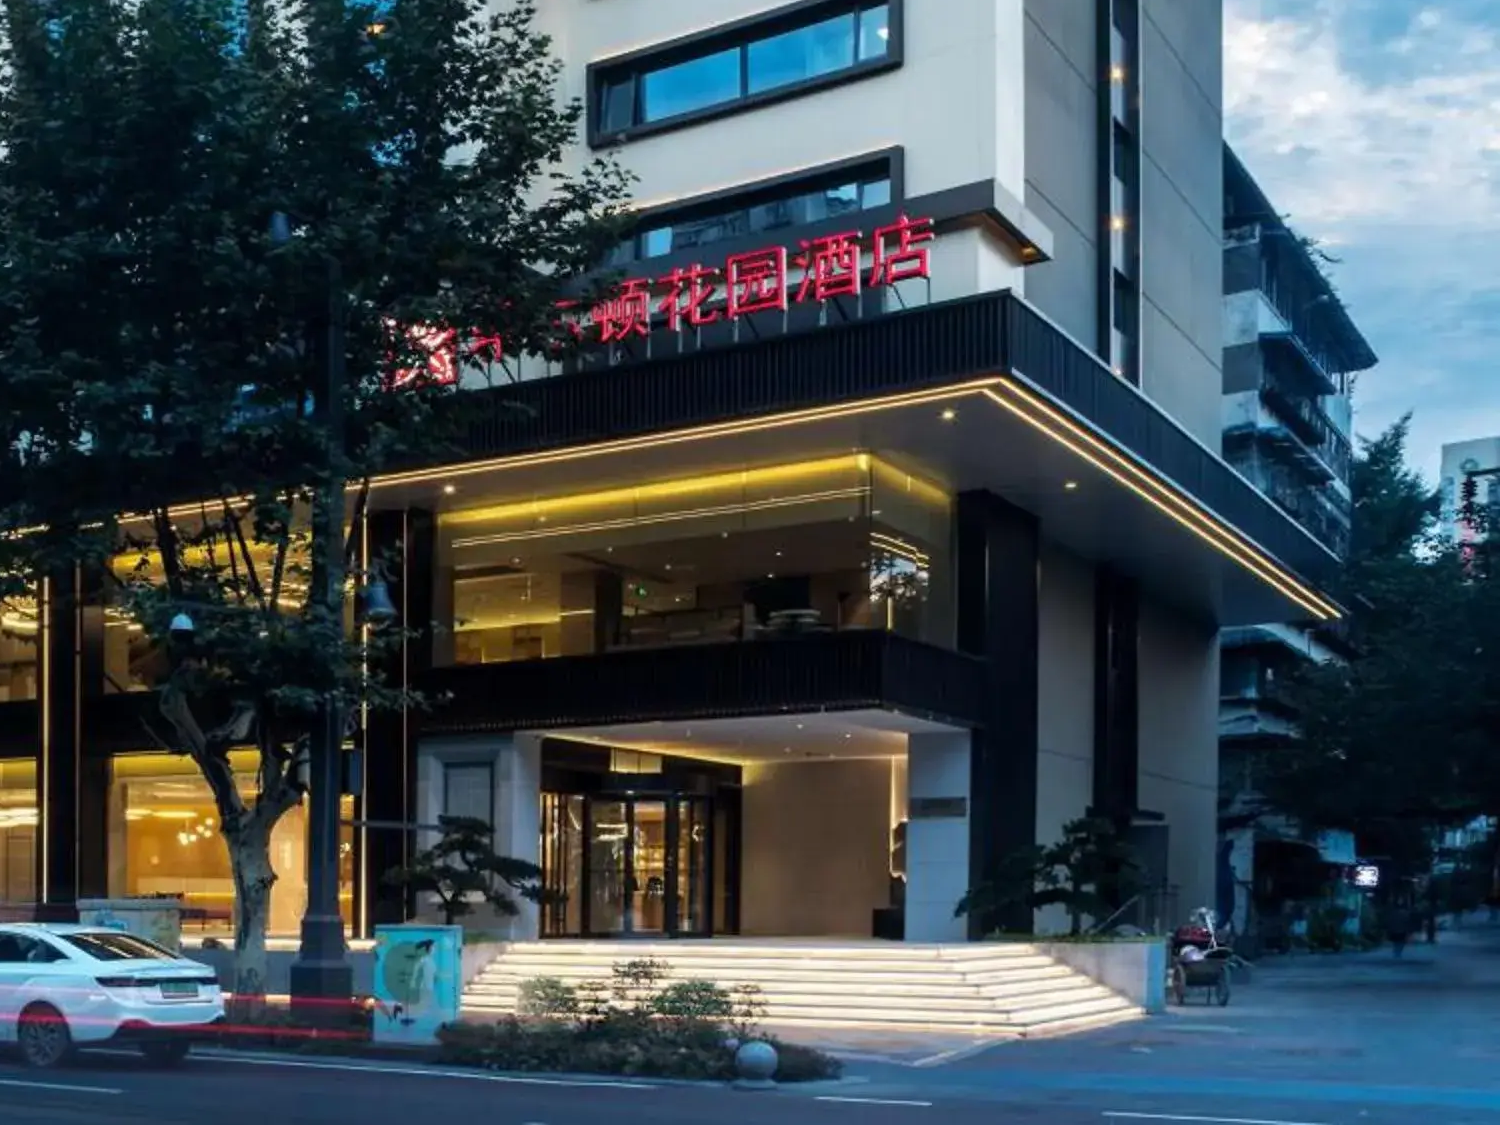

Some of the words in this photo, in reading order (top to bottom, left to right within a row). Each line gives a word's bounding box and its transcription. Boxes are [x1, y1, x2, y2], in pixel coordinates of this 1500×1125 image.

[470, 215, 934, 363] 顿花园酒店
